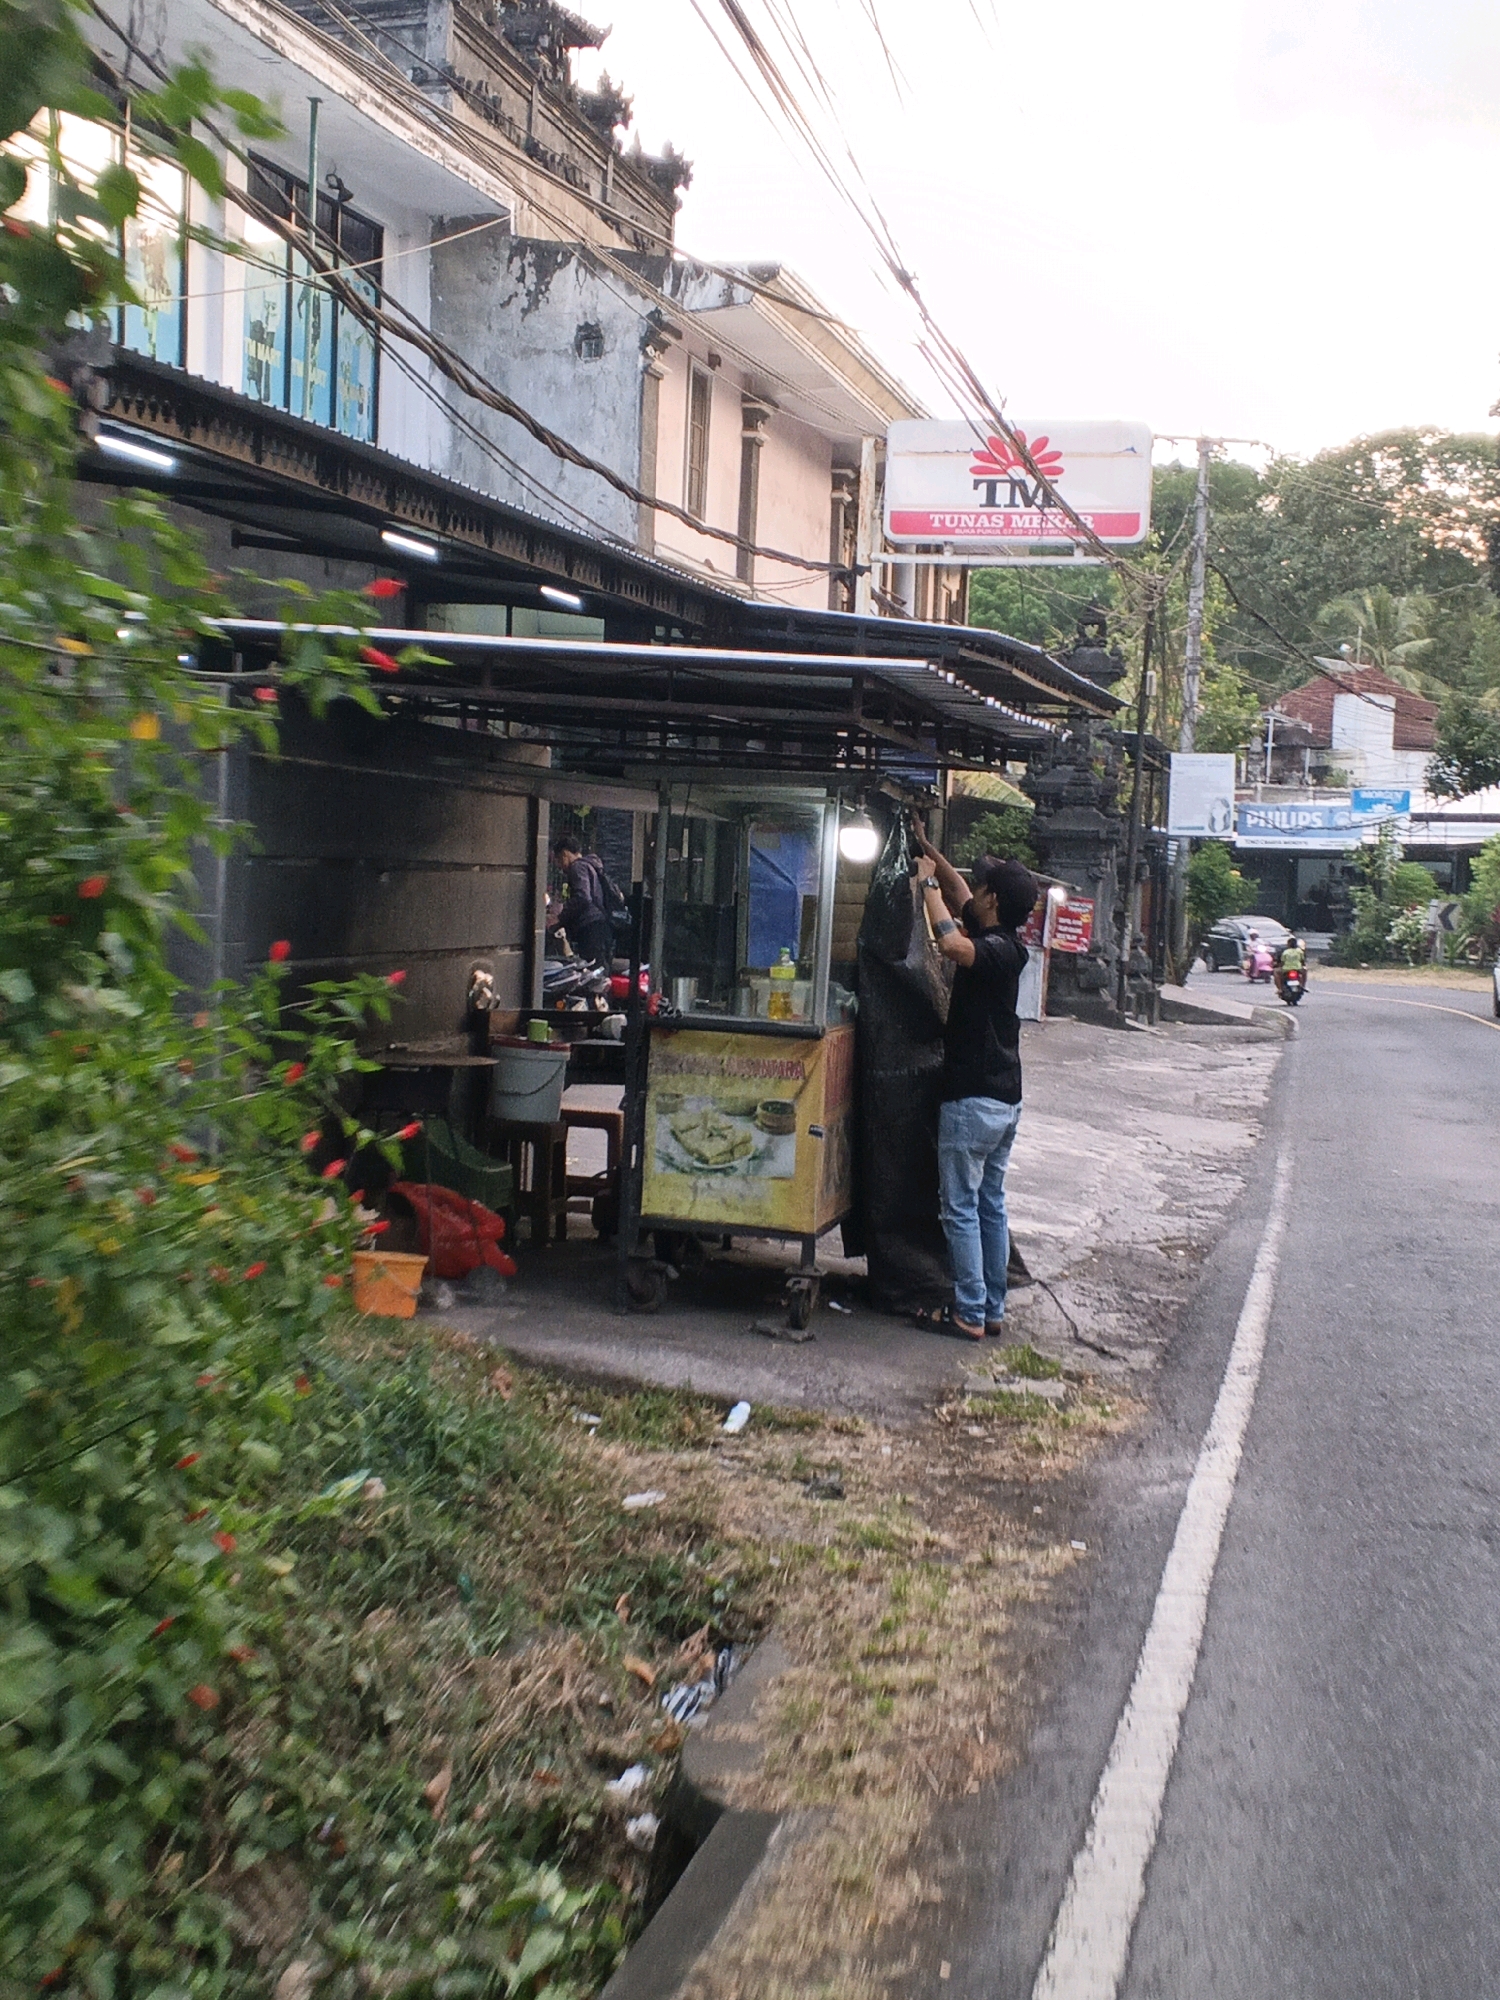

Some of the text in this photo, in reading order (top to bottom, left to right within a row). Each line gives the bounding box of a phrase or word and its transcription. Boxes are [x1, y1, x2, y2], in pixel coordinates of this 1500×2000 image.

[973, 478, 1060, 508] TM
[929, 513, 1006, 529] TUNAS
[1245, 809, 1323, 829] PHILIPS
